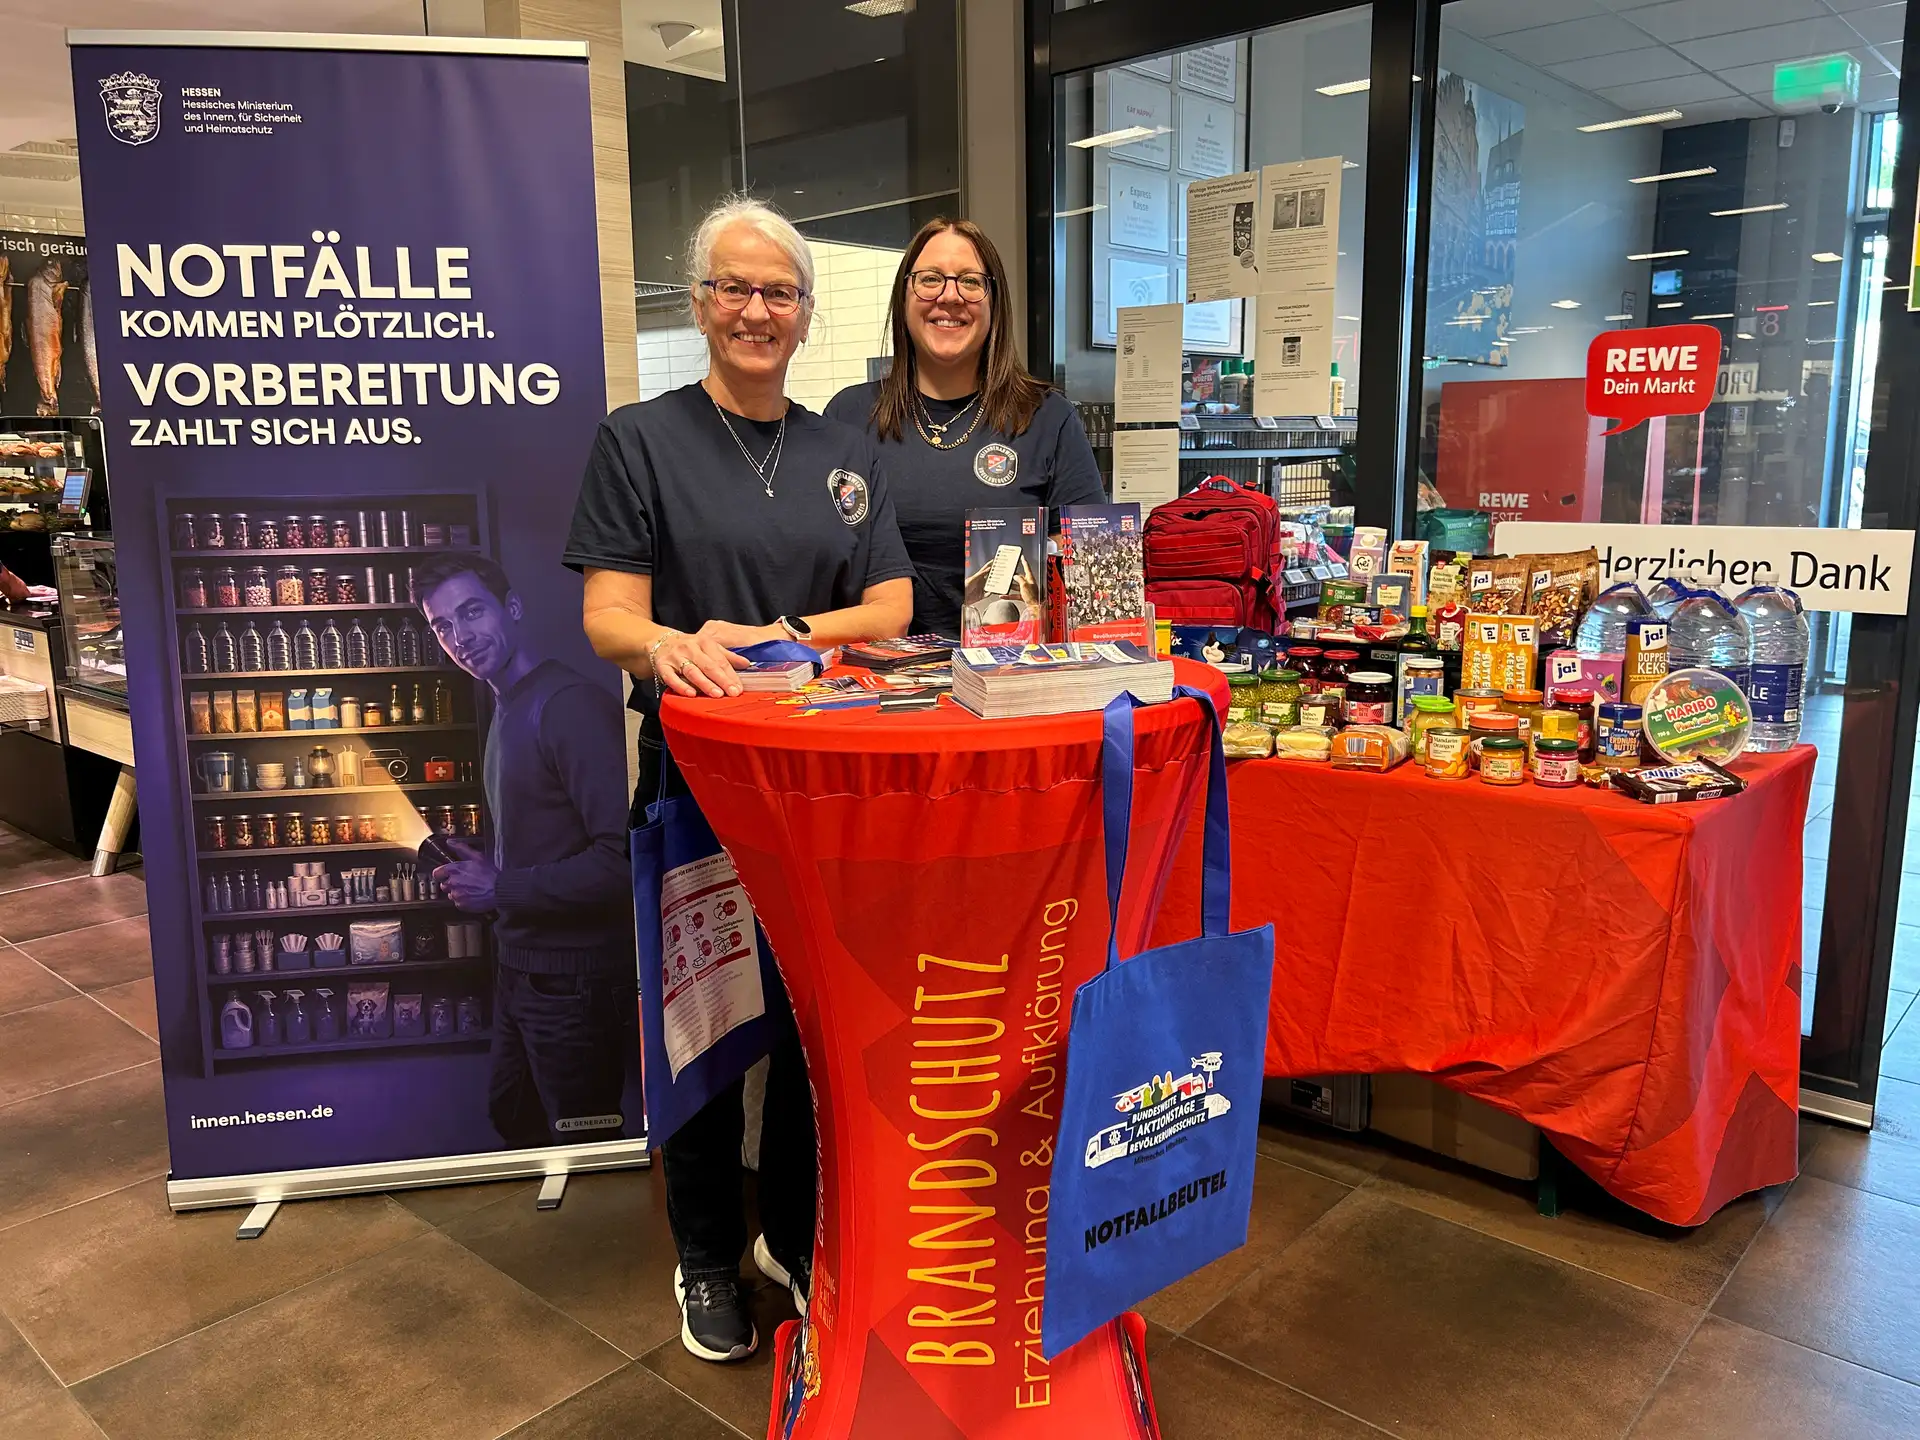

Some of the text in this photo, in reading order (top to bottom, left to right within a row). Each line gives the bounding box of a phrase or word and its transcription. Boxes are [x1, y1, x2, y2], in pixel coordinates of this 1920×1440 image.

[181, 88, 221, 97] HESSEN
[183, 100, 293, 111] Hessisches Ministerium
[183, 112, 302, 123] des Innern, für Sicherheit
[184, 124, 273, 135] und Heimatschutz
[1130, 186, 1152, 199] Express
[0, 236, 36, 253] isch
[116, 230, 472, 299] NOTFÄLLE
[121, 304, 495, 339] KOMMEN PLÖTZLICH.
[1605, 345, 1698, 373] REWE
[123, 362, 561, 406] VORBEREITUNG
[1603, 376, 1696, 395] Dein Markt
[129, 417, 422, 446] ZAHLT SICH AUS.
[1478, 492, 1529, 508] REWE
[1488, 511, 1523, 526] ESTE
[1473, 574, 1489, 588] ja!
[1533, 573, 1548, 589] ja!
[1790, 551, 1891, 592] Dank
[1483, 626, 1496, 640] ja!
[1517, 627, 1531, 642] ja!
[1644, 628, 1664, 647] ja!
[1482, 653, 1491, 689] BUTTE
[1516, 656, 1526, 690] BUTTE
[1557, 662, 1577, 679] ja!
[1637, 662, 1666, 675] KEKS
[1665, 696, 1717, 722] HARIBO
[190, 1104, 334, 1130] innen.hessen.de
[1131, 1095, 1178, 1125] BUNDESWEITE
[1136, 1100, 1196, 1138] AKTIONSTAGE
[561, 1119, 571, 1129] AI
[1129, 1111, 1207, 1154] BEVÖLKERUNGSSCHUTZ
[906, 952, 1009, 1367] BRANDSCHUTZ
[1014, 897, 1078, 1409] Aufklärung & Erziehung
[1085, 1169, 1228, 1254] NOTFALLBEUTEL
